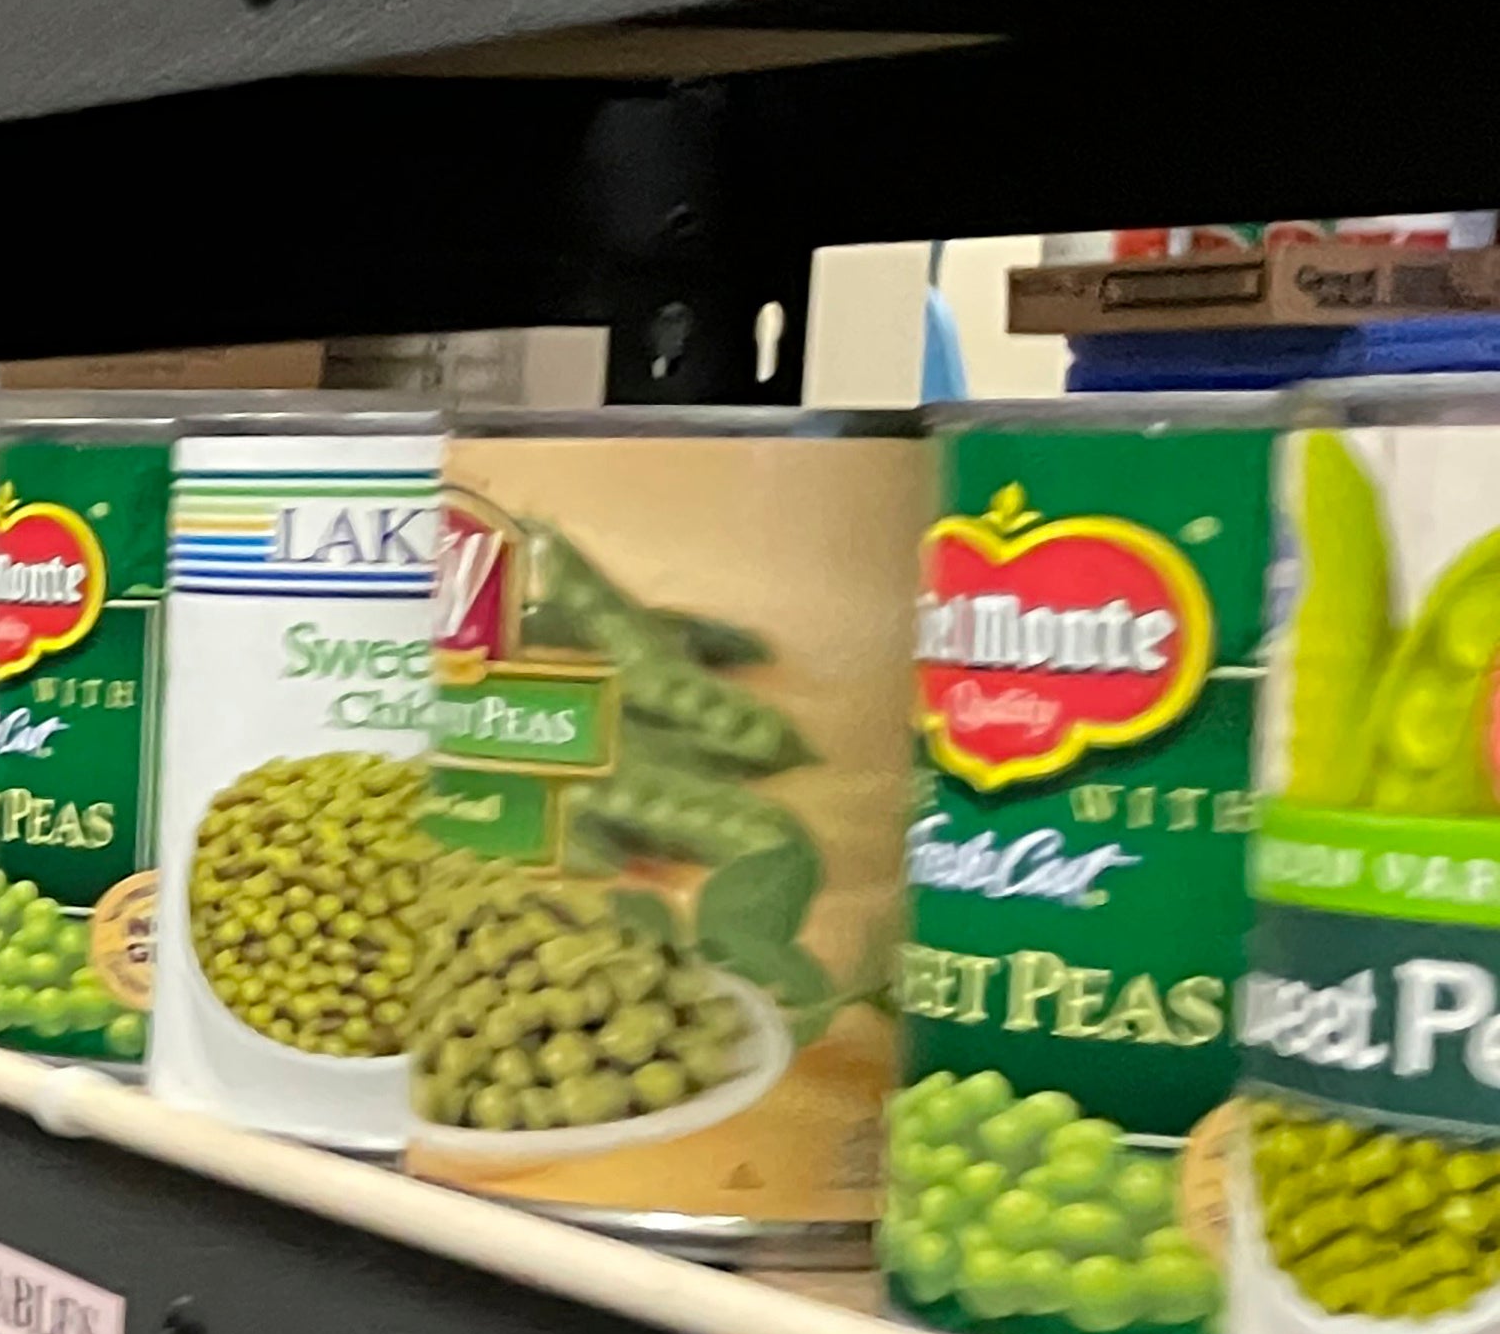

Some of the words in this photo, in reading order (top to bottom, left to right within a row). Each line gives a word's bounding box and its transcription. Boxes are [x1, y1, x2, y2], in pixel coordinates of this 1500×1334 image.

[973, 594, 1177, 672] Monte
[30, 676, 139, 710] WITH
[481, 695, 578, 748] PEAS
[3, 787, 116, 849] PEAS
[1003, 950, 1226, 1048] PEAS
